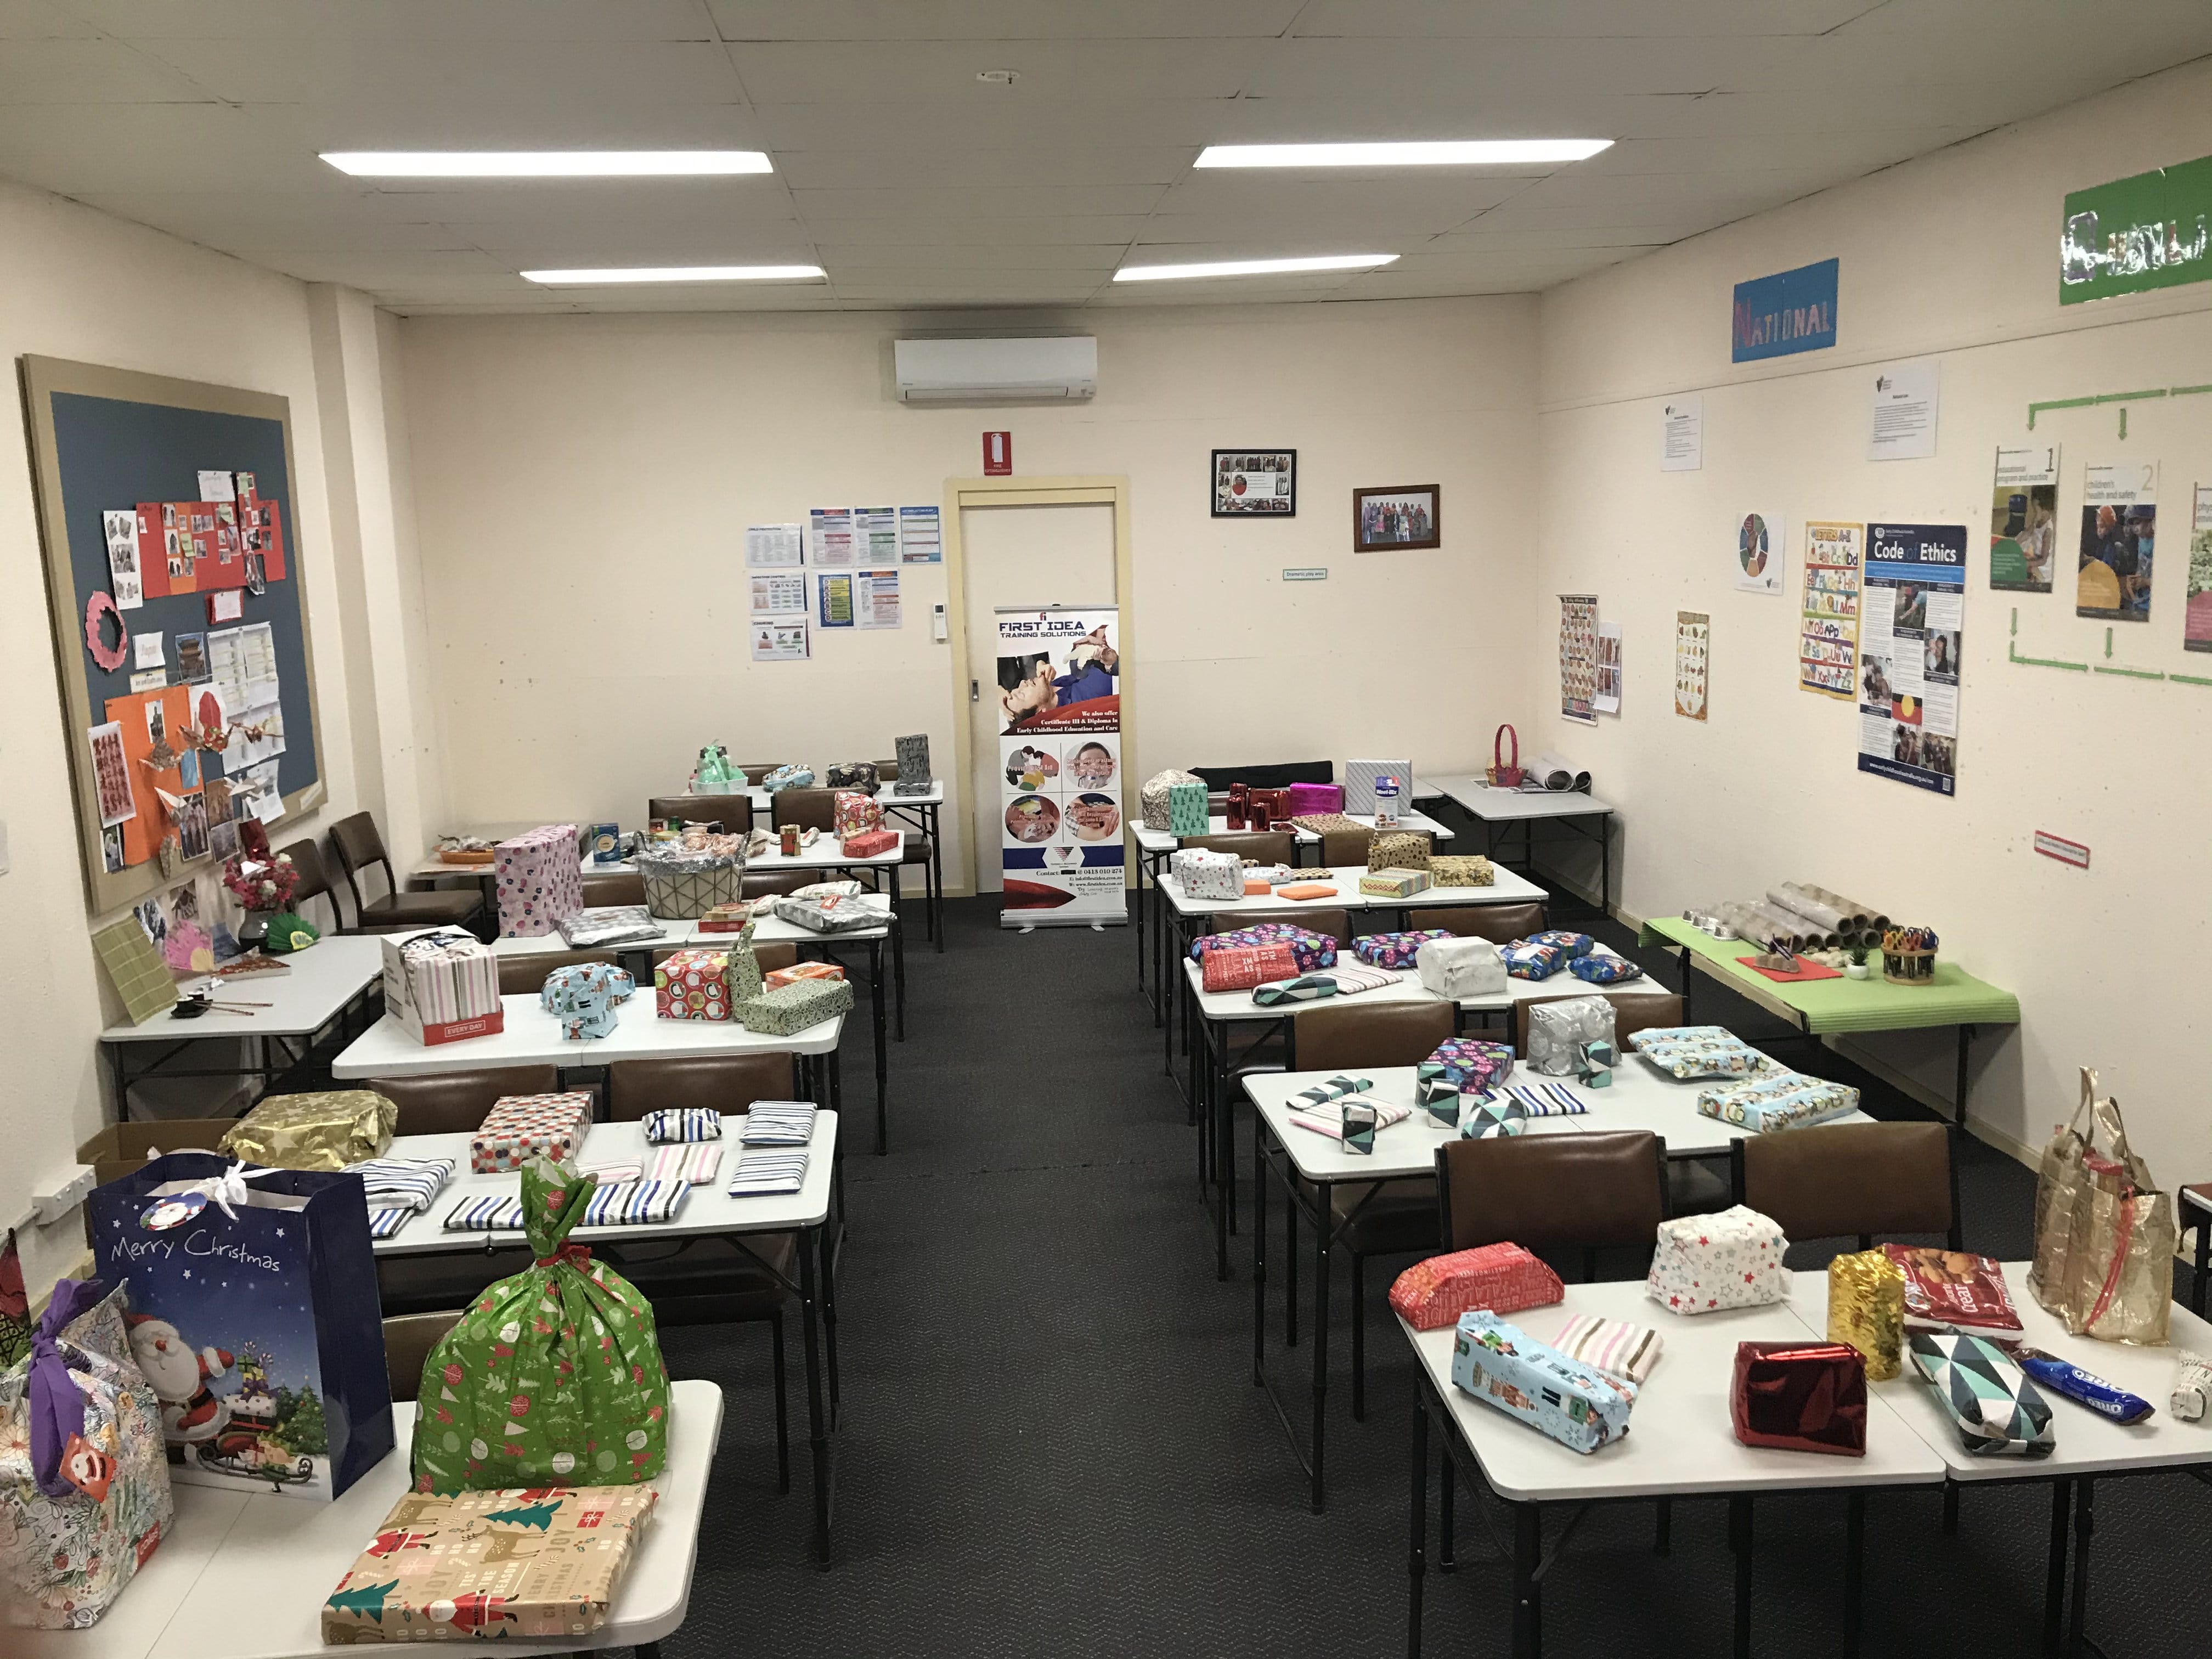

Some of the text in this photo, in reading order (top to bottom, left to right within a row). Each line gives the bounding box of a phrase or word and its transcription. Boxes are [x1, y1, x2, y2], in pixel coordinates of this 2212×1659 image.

[1732, 297, 1830, 348] NATIONAL
[2045, 448, 2054, 472] 1
[2141, 464, 2153, 490] 2
[1874, 540, 1957, 562] Code of Ethics
[1847, 552, 1858, 566] Dd
[999, 621, 1085, 631] FIRST IDEA
[1260, 951, 1269, 960] AS
[1268, 950, 1277, 960] XM
[448, 1026, 468, 1035] EVERY
[111, 1229, 280, 1271] Merry Christmas
[2087, 1398, 2122, 1413] OREO
[460, 1501, 475, 1510] HO
[477, 1500, 492, 1509] HO
[495, 1500, 510, 1509] HO
[620, 1497, 634, 1506] HO
[545, 1529, 575, 1553] JOY
[597, 1539, 612, 1550] HO
[430, 1544, 446, 1555] HO
[448, 1544, 464, 1554] HO
[466, 1543, 482, 1554] HO
[477, 1570, 497, 1587] THE
[492, 1562, 520, 1594] SEASON
